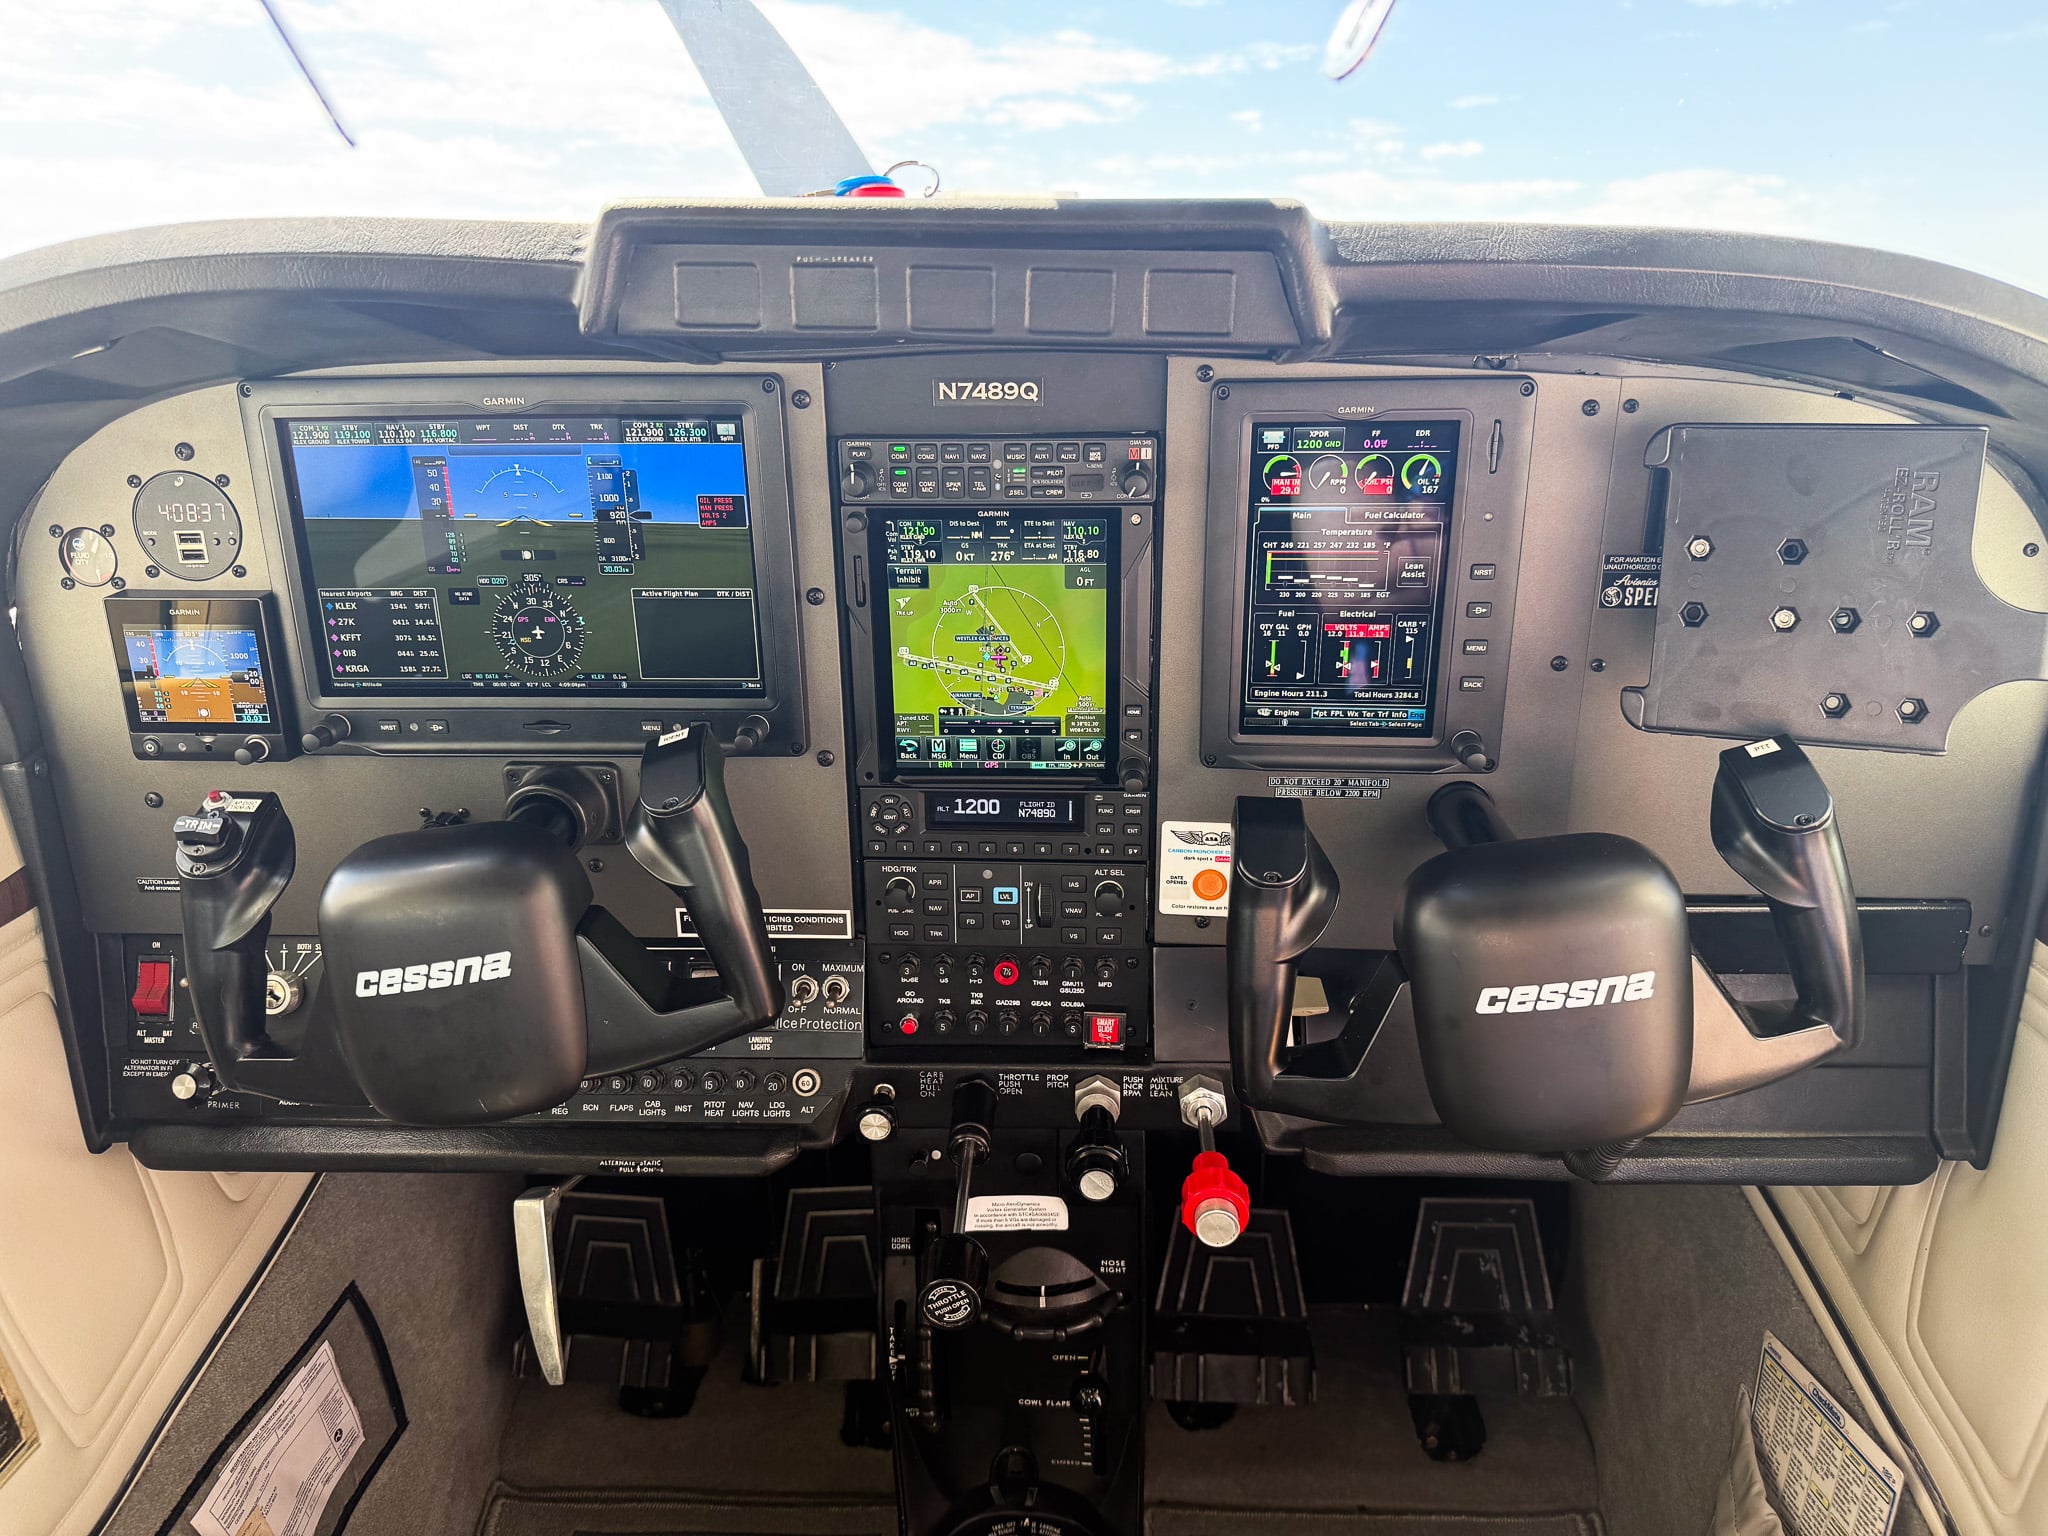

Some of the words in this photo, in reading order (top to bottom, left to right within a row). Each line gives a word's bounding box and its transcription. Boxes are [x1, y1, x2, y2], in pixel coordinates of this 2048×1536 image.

[939, 382, 1038, 401] N7489Q
[483, 398, 524, 406] GARMIN
[1296, 440, 1322, 449] 1200
[599, 494, 619, 502] 1000
[158, 503, 225, 522] 4:08:37
[1904, 471, 1940, 546] RAM
[1292, 511, 1312, 520] Main
[1365, 511, 1382, 519] Fuel
[1384, 511, 1425, 520] Calculator
[903, 527, 935, 536] 121.90
[1067, 527, 1099, 535] 110.10
[1321, 528, 1372, 537] Temperature
[903, 550, 936, 559] 119.10
[1067, 550, 1099, 558] 116.80
[1401, 570, 1426, 578] Assist
[1614, 575, 1658, 586] Avionics
[1254, 690, 1280, 698] Engine
[954, 798, 1000, 815] 1200
[1018, 808, 1056, 818] N7489Q
[184, 819, 213, 830] TRIM
[822, 964, 864, 972] MAXIMUM
[355, 950, 512, 998] cessna
[1474, 970, 1656, 1016] cessna
[800, 1018, 862, 1030] Protection
[998, 1073, 1040, 1082] THROTTLE
[1150, 1076, 1184, 1084] MIXTURE
[208, 1101, 240, 1109] PRIMER
[704, 1109, 724, 1117] HEAT
[928, 1290, 967, 1310] THROTTLE
[935, 1306, 952, 1316] PUSH
[952, 1298, 969, 1308] OPEN
[1018, 1398, 1042, 1406] COWL
